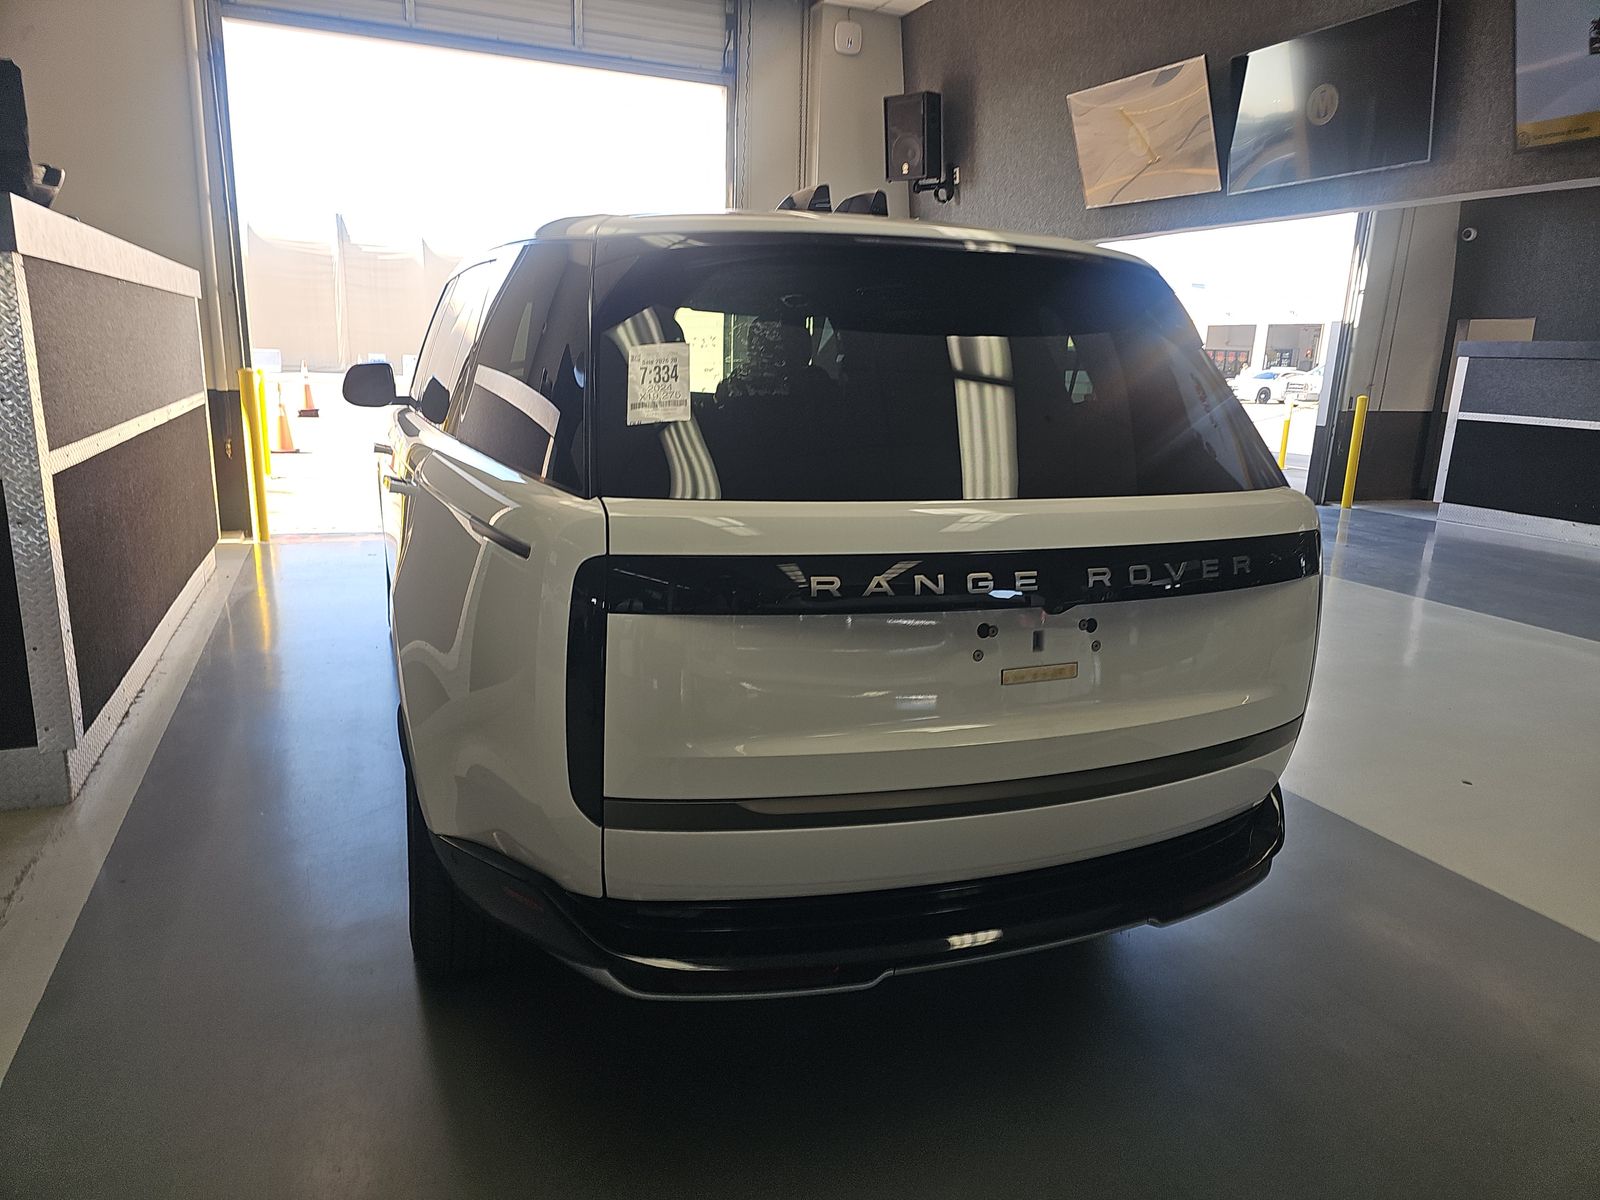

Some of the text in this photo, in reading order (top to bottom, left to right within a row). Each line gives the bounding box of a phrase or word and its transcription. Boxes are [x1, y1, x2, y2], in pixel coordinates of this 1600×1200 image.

[640, 364, 679, 385] 7:334
[647, 384, 673, 393] 2024
[809, 556, 1252, 597] RANGE ROVER
